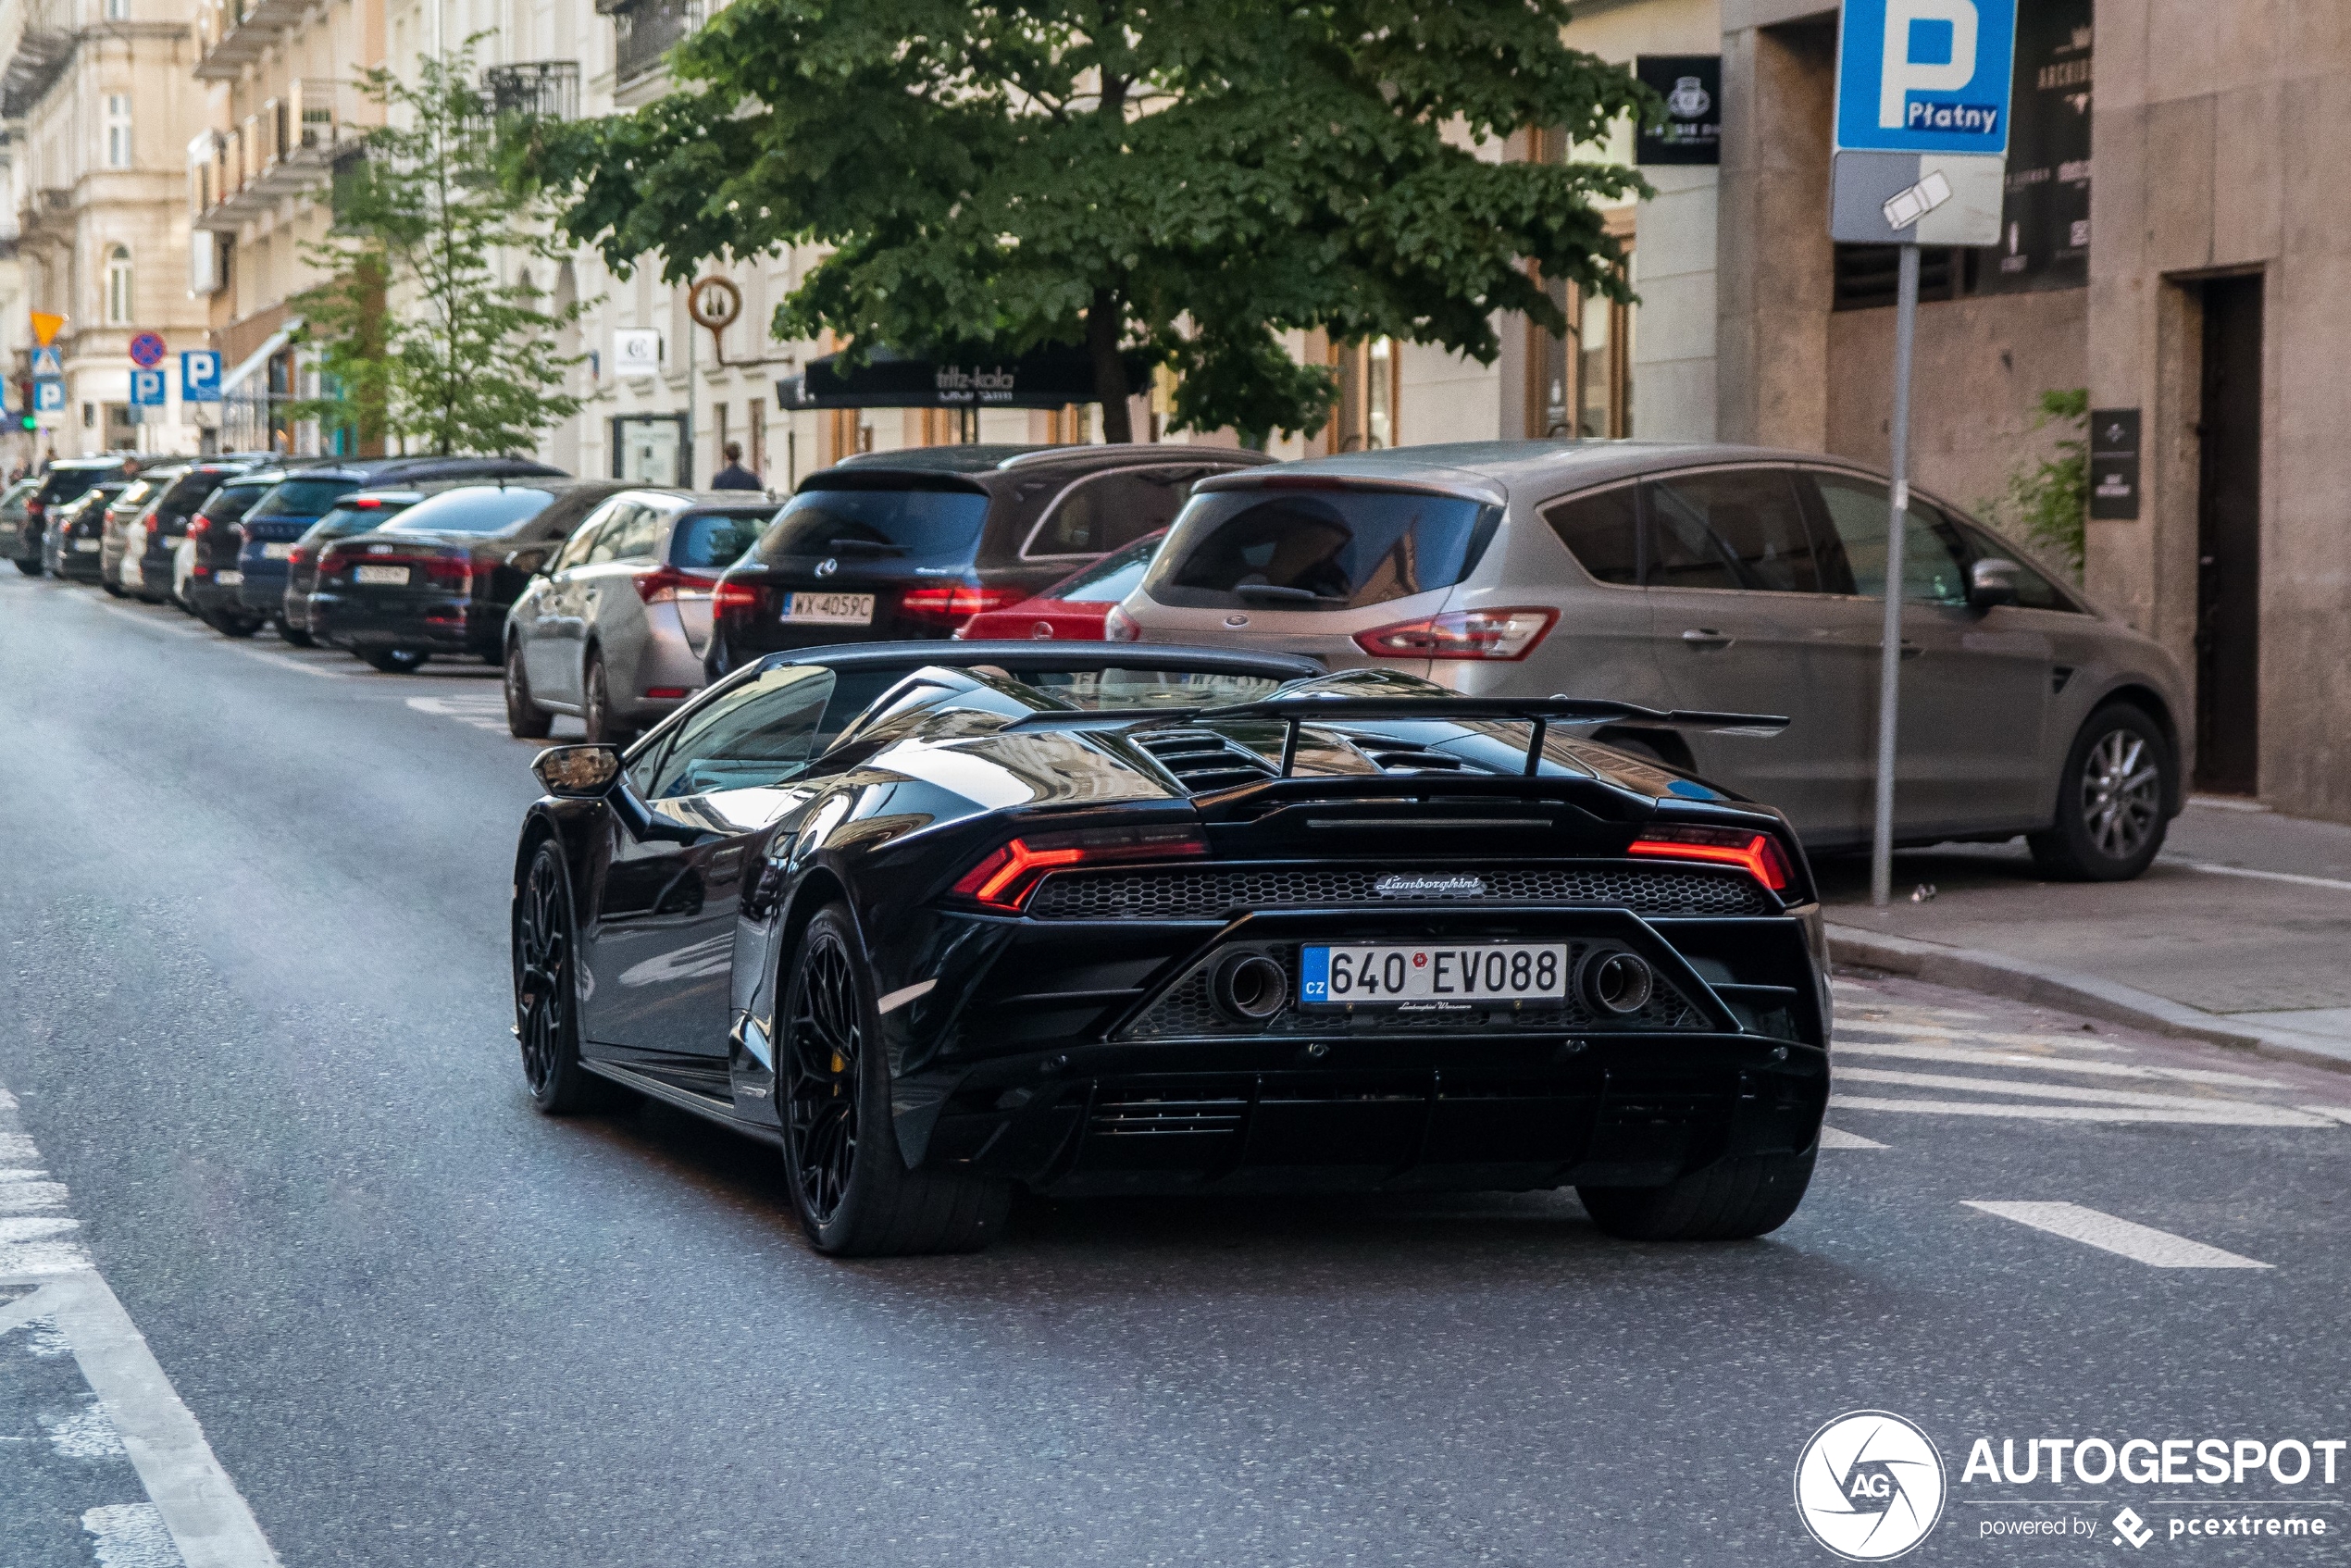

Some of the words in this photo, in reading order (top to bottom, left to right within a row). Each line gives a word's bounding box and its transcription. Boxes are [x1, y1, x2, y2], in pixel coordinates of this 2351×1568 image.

[1879, 0, 1979, 129] P
[1908, 102, 1997, 135] Płatny
[188, 354, 215, 387] P
[40, 384, 61, 411] P
[138, 372, 159, 404] P
[1376, 875, 1480, 891] Lamborghini
[1306, 981, 1325, 994] CZ
[1331, 951, 1406, 993] 640
